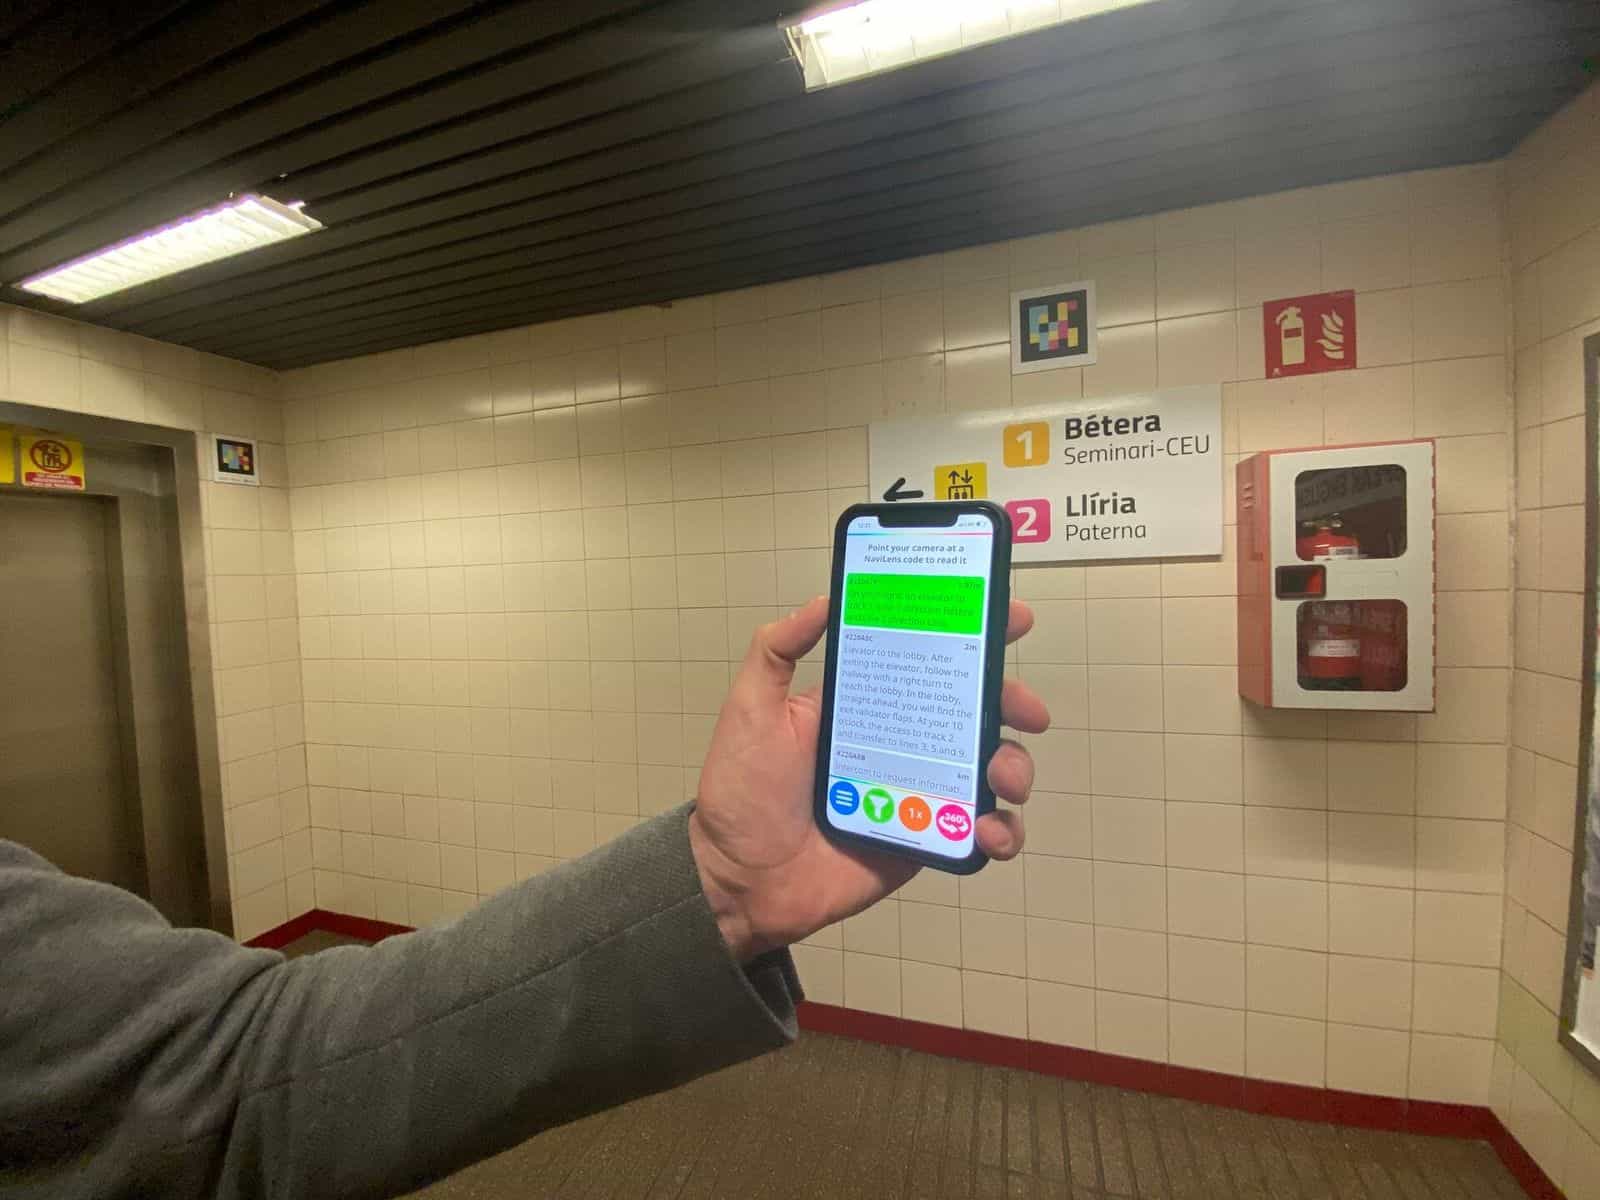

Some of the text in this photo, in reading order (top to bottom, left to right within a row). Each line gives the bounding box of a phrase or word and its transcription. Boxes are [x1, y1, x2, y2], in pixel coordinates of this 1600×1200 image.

[1015, 413, 1162, 460] 1 Bétera
[1063, 434, 1210, 465] Seminari-CEU
[1016, 491, 1137, 537] 2 Llíria
[1065, 523, 1147, 542] Paterna
[867, 543, 965, 554] Point your camera at a
[864, 554, 967, 565] NaviLens code to read it
[876, 648, 886, 657] to
[930, 653, 953, 664] After
[871, 660, 886, 670] the
[924, 665, 952, 676] follow
[953, 669, 969, 679] the
[943, 681, 953, 690] to
[917, 689, 932, 699] the
[902, 703, 918, 711] you
[919, 703, 935, 713] will
[937, 706, 954, 717] find
[956, 709, 973, 719] the
[928, 719, 950, 728] your
[912, 728, 922, 737] to
[908, 806, 924, 821] 1x
